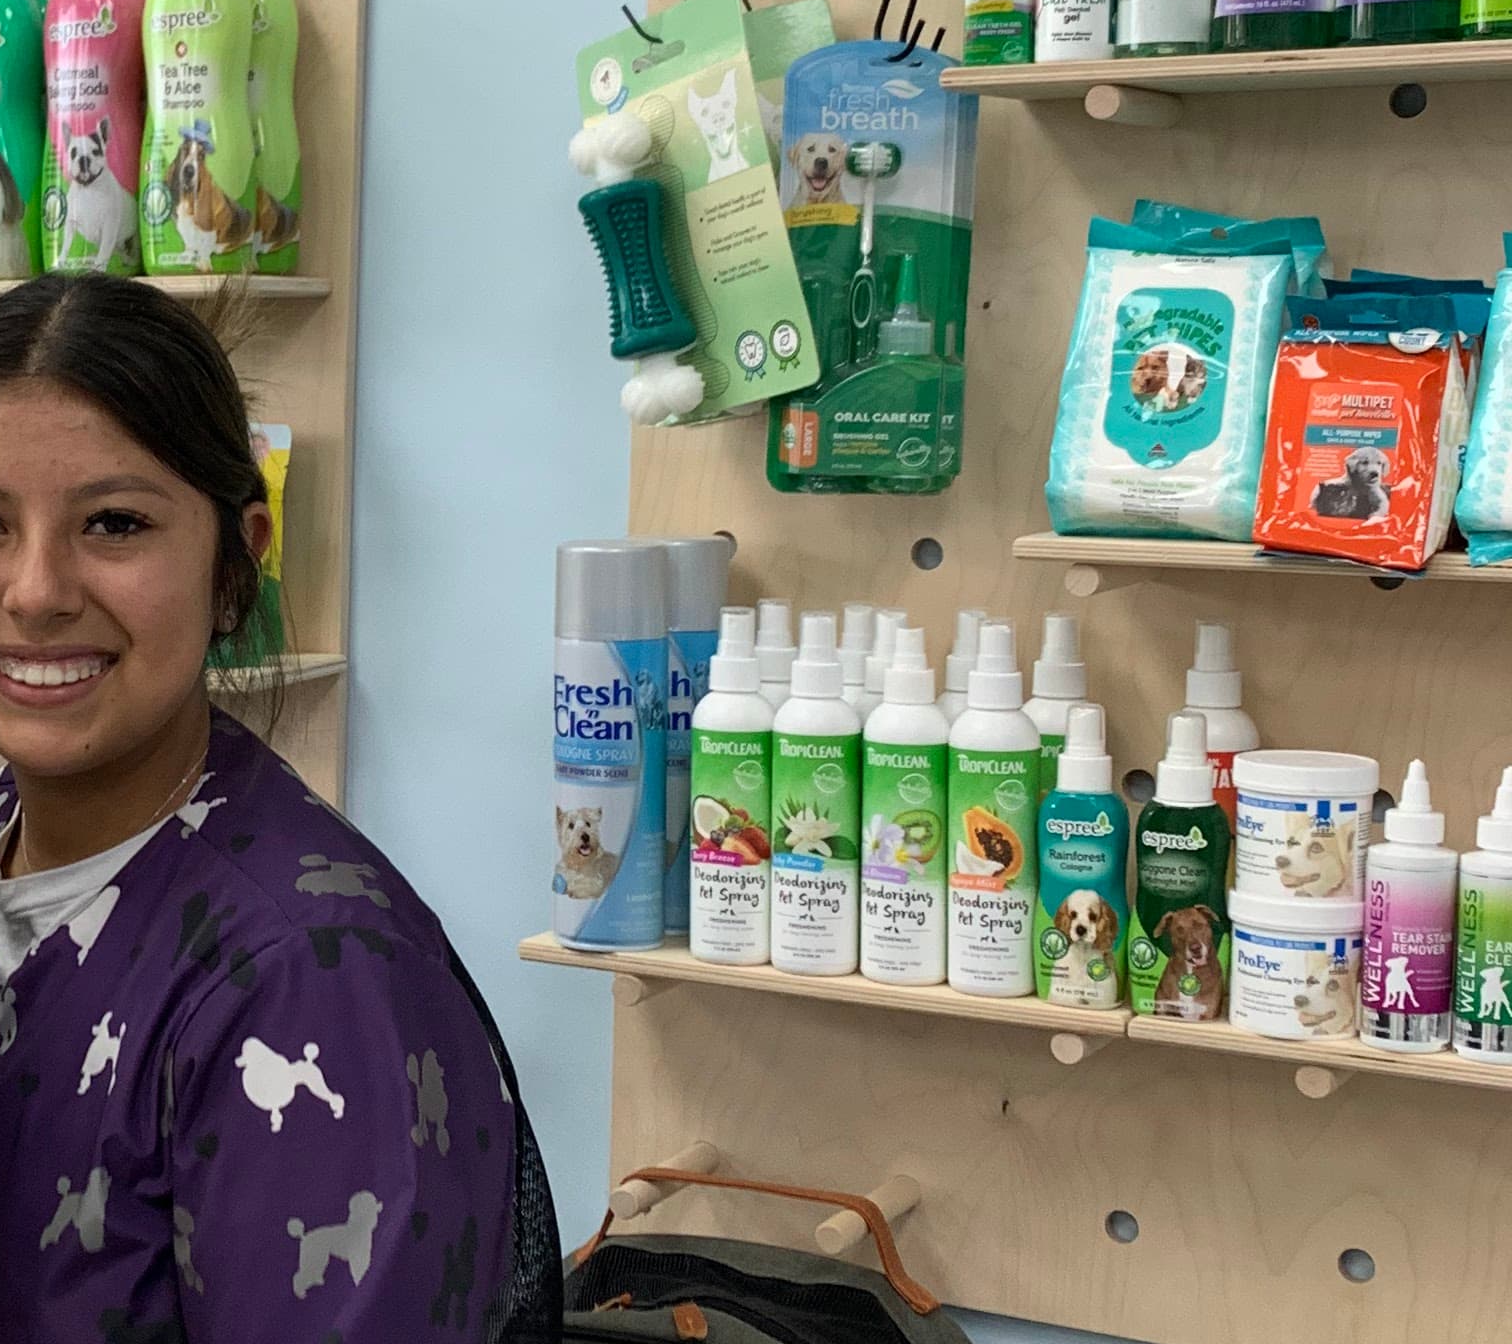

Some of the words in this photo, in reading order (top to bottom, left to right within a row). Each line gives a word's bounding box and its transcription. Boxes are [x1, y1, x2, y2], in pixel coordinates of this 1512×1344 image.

[50, 20, 104, 44] espree
[152, 10, 209, 35] espree
[159, 64, 178, 78] Tea
[179, 62, 209, 77] Tree
[79, 80, 110, 98] Soda
[174, 81, 202, 94] Aloe
[828, 84, 891, 110] fresh
[821, 106, 920, 131] breath
[1166, 321, 1224, 358] WIPES
[1342, 394, 1394, 409] MULTIPET
[833, 412, 871, 424] ORAL
[871, 412, 907, 424] CARE
[909, 412, 931, 423] KIT
[802, 421, 815, 457] LARGE
[554, 674, 634, 712] Fresh
[555, 704, 634, 741] Clean
[595, 747, 635, 761] SPRAY
[603, 768, 630, 779] SCENT
[1047, 820, 1102, 839] espree
[1142, 832, 1194, 853] espree
[1048, 848, 1106, 864] Rainforest
[694, 867, 766, 889] Deodorizing
[774, 871, 847, 895] Deodorizing
[699, 884, 713, 900] Pet
[719, 888, 760, 907] Spray
[778, 891, 793, 905] Pet
[798, 893, 840, 914] Spray
[952, 890, 1029, 915] Deodorizing
[865, 900, 879, 917] Pet
[883, 905, 926, 926] Spray
[957, 911, 974, 926] Pet
[979, 914, 1023, 934] Spray
[1362, 879, 1385, 1004] WELLNESS
[1390, 942, 1446, 956] REMOVER
[1391, 931, 1425, 945] TEAR
[1238, 949, 1282, 974] ProEye
[1457, 888, 1478, 1014] WELLNESS
